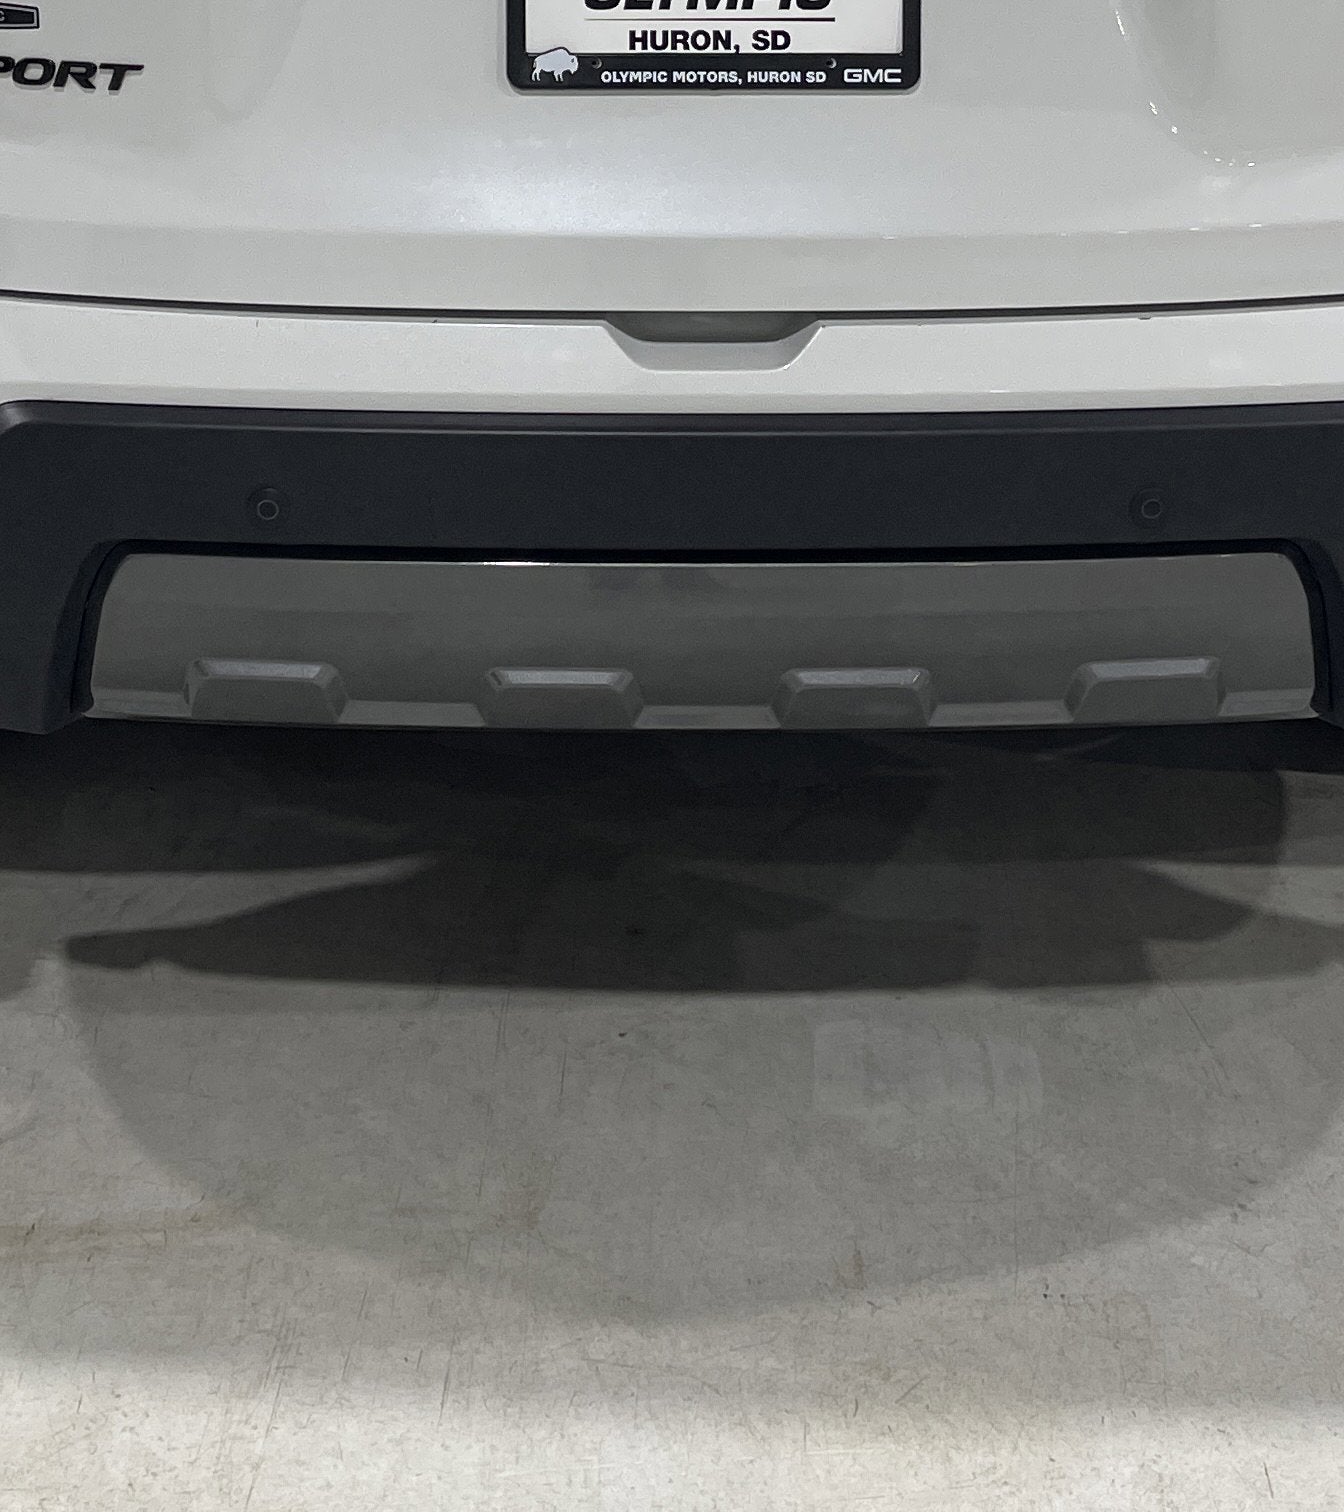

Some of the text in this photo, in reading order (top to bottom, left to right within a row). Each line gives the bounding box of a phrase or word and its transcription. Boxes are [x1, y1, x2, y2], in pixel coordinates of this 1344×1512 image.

[628, 30, 791, 54] HURON, SD
[601, 70, 827, 85] OLYMPIC MOTORS, HURON SD
[843, 68, 902, 83] GMC
